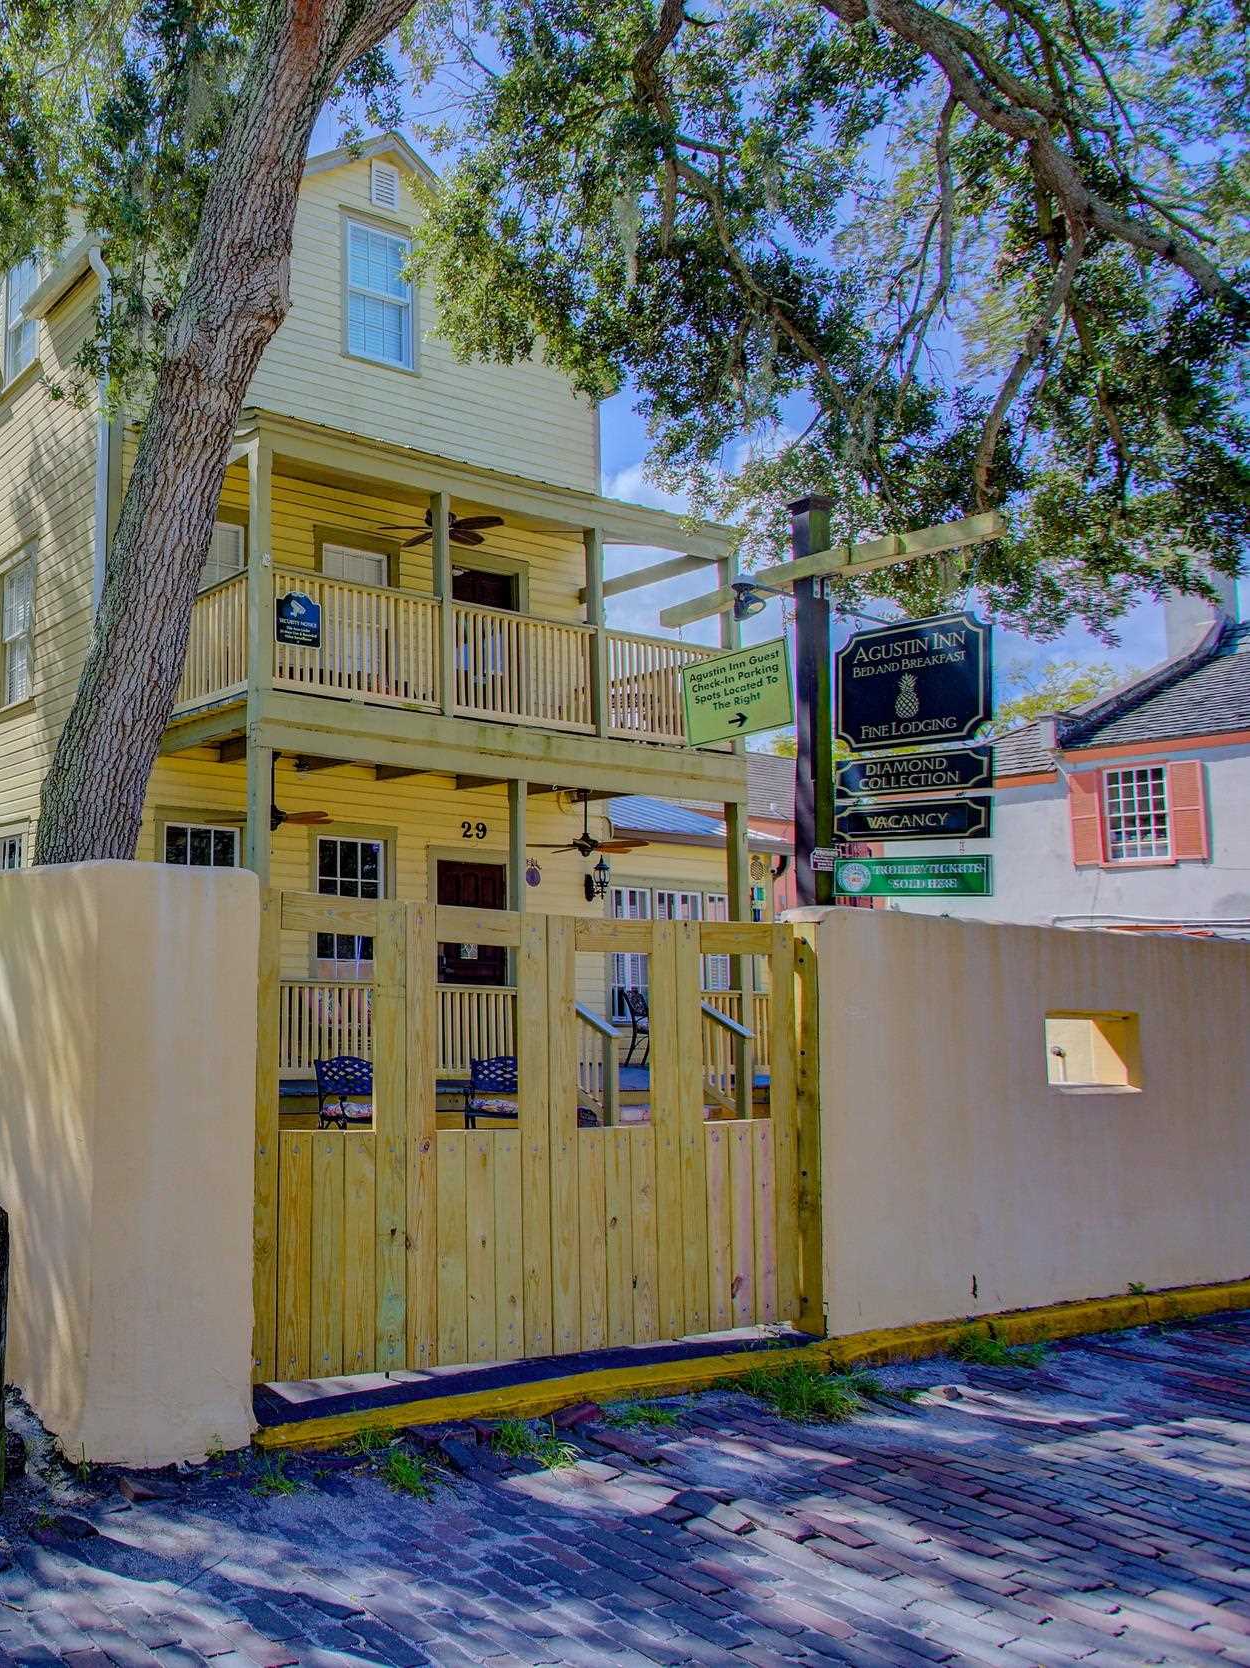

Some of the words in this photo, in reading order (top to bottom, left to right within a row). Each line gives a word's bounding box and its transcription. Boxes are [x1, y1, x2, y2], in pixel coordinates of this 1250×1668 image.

[852, 638, 928, 664] AGUSTIN
[932, 631, 966, 650] INN
[690, 666, 726, 682] Agustin
[730, 661, 746, 671] Inn
[750, 650, 780, 665] Guest
[853, 666, 874, 678] BED
[876, 662, 900, 674] AND
[902, 650, 966, 670] BREAKFAST
[692, 675, 735, 693] Check-In
[738, 664, 779, 680] Parking
[695, 692, 721, 705] Spots
[724, 678, 763, 696] Located
[766, 676, 778, 684] To
[712, 701, 731, 711] The
[734, 692, 761, 705] Right
[861, 724, 890, 739] FINE
[891, 717, 957, 736] LODGING
[865, 757, 947, 776] DIAMOND
[858, 771, 960, 790] COLLECTION
[461, 821, 487, 839] 29
[866, 812, 949, 829] VACANCY
